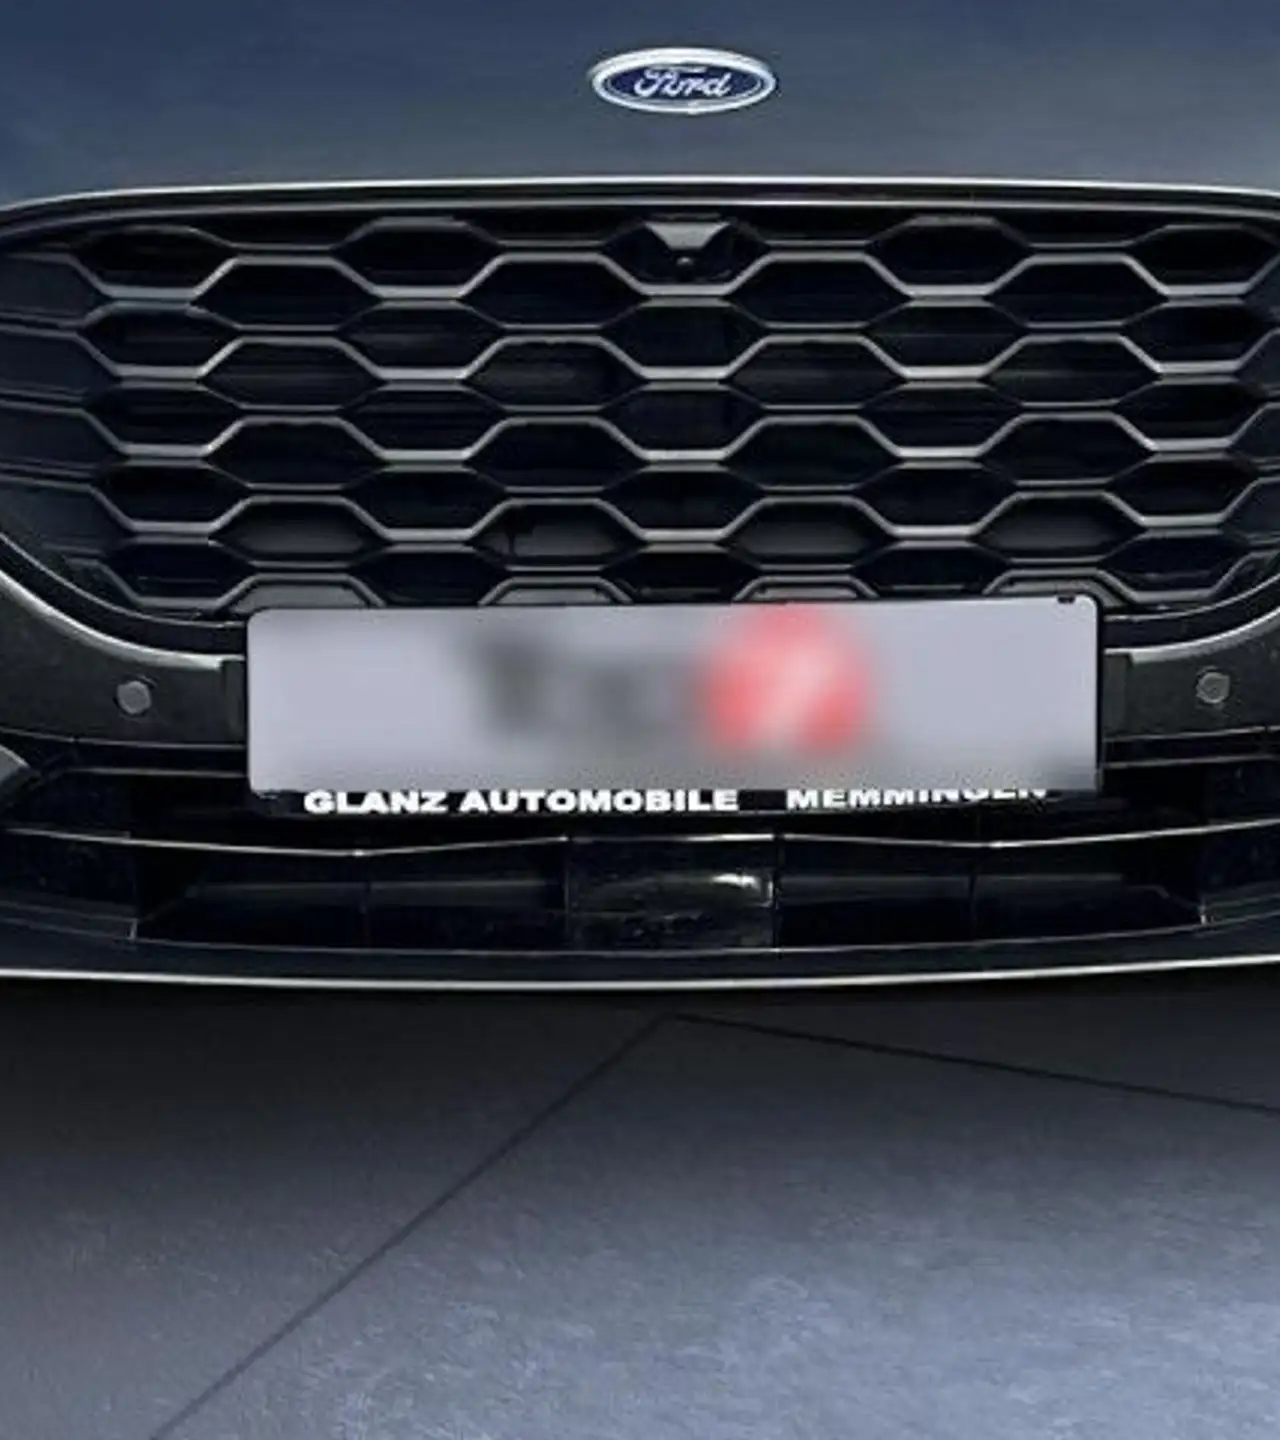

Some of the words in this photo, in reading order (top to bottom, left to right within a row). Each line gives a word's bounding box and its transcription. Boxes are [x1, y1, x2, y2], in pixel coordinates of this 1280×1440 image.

[634, 66, 732, 97] Ford
[304, 790, 449, 814] GLANZ
[459, 789, 739, 812] AUTOMOBILE
